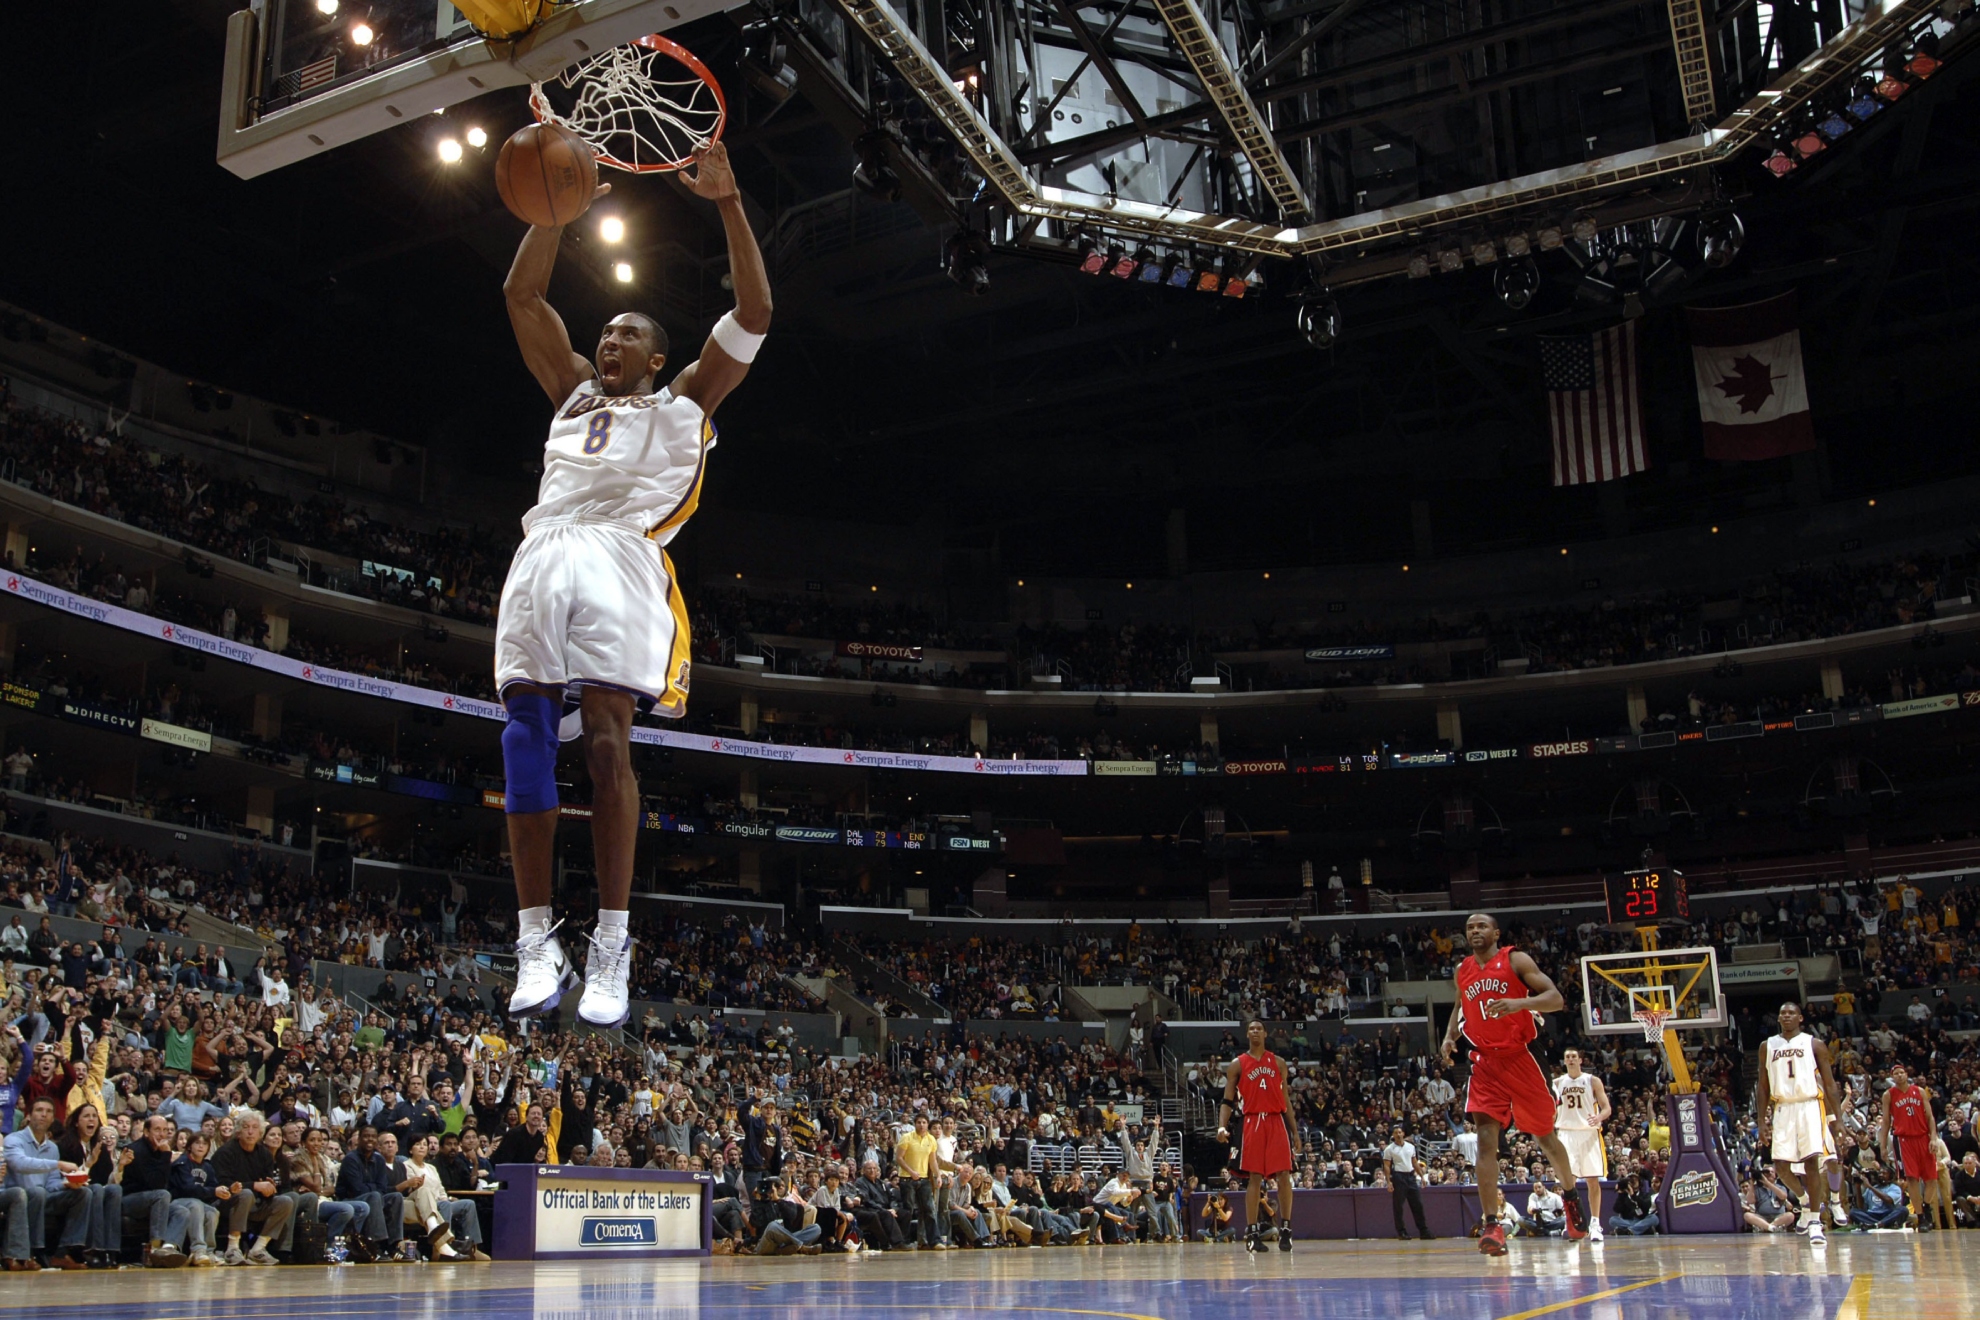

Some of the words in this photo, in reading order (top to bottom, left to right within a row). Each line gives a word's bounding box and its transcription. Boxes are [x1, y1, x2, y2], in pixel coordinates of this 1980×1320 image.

[582, 407, 614, 456] 8
[21, 580, 65, 606] Sempra
[67, 599, 108, 620] Energy
[175, 628, 216, 652] Sempra
[218, 641, 254, 664] Energy
[866, 645, 912, 657] TOYOTA
[1311, 649, 1343, 657] BUD
[1344, 647, 1389, 656] LIGHT
[313, 669, 355, 689] Sempra
[357, 678, 395, 698] Energy
[3, 682, 40, 700] SPONSOR
[5, 693, 36, 709] LAKERS
[455, 698, 493, 717] Sempra
[1883, 707, 1901, 715] Bank
[1909, 702, 1937, 712] America
[80, 708, 136, 729] DIRECTV
[153, 726, 182, 741] Sempra
[183, 733, 209, 747] Energy
[631, 729, 665, 745] Energy
[723, 741, 759, 755] Sempra
[761, 746, 796, 761] Energy
[1489, 749, 1510, 759] WEST
[1511, 749, 1518, 758] 2
[1533, 742, 1589, 758] STAPLES
[855, 753, 894, 767] Sempra
[896, 755, 929, 770] Energy
[1339, 756, 1351, 764] LA
[1362, 755, 1379, 763] TOR
[1409, 754, 1447, 764] PEPSI
[985, 761, 1024, 774] Sempra
[1026, 762, 1060, 775] Energy
[1105, 765, 1130, 774] Sempra
[1131, 765, 1154, 775] Energy
[1242, 762, 1287, 772] TOYOTA
[1340, 763, 1351, 772] 31
[485, 794, 499, 804] THE
[647, 811, 659, 821] 92
[645, 821, 662, 830] 105
[678, 823, 695, 833] NBA
[725, 822, 770, 837] cingular
[778, 828, 803, 837] BUD
[803, 829, 838, 840] LIGHT
[846, 829, 863, 838] DAL
[875, 831, 886, 839] 79
[909, 832, 925, 841] END
[846, 837, 863, 846] POR
[875, 839, 886, 848] 79
[904, 840, 920, 849] NBA
[953, 838, 968, 847] FSN
[972, 839, 990, 849] WEST
[1632, 873, 1659, 889] 1:12
[1625, 889, 1658, 917] 23
[1719, 971, 1737, 979] Bank
[1746, 968, 1776, 977] America
[1464, 978, 1508, 1001] RAPTORS
[1772, 1048, 1804, 1062] LAKERS
[1247, 1066, 1276, 1081] RAPTORS
[1787, 1060, 1795, 1078] 1
[1259, 1078, 1267, 1091] 4
[1562, 1086, 1586, 1095] LAKERS
[1567, 1095, 1583, 1109] 31
[1895, 1097, 1921, 1108] RAPTORS
[1906, 1106, 1915, 1117] 31
[1680, 1110, 1699, 1146] MGD
[1670, 1178, 1719, 1197] GENUINE
[1677, 1187, 1711, 1200] DRAFT
[543, 1187, 589, 1209] Official
[592, 1189, 620, 1209] Bank
[624, 1189, 637, 1209] of
[637, 1191, 655, 1209] the
[657, 1191, 691, 1210] Lakers
